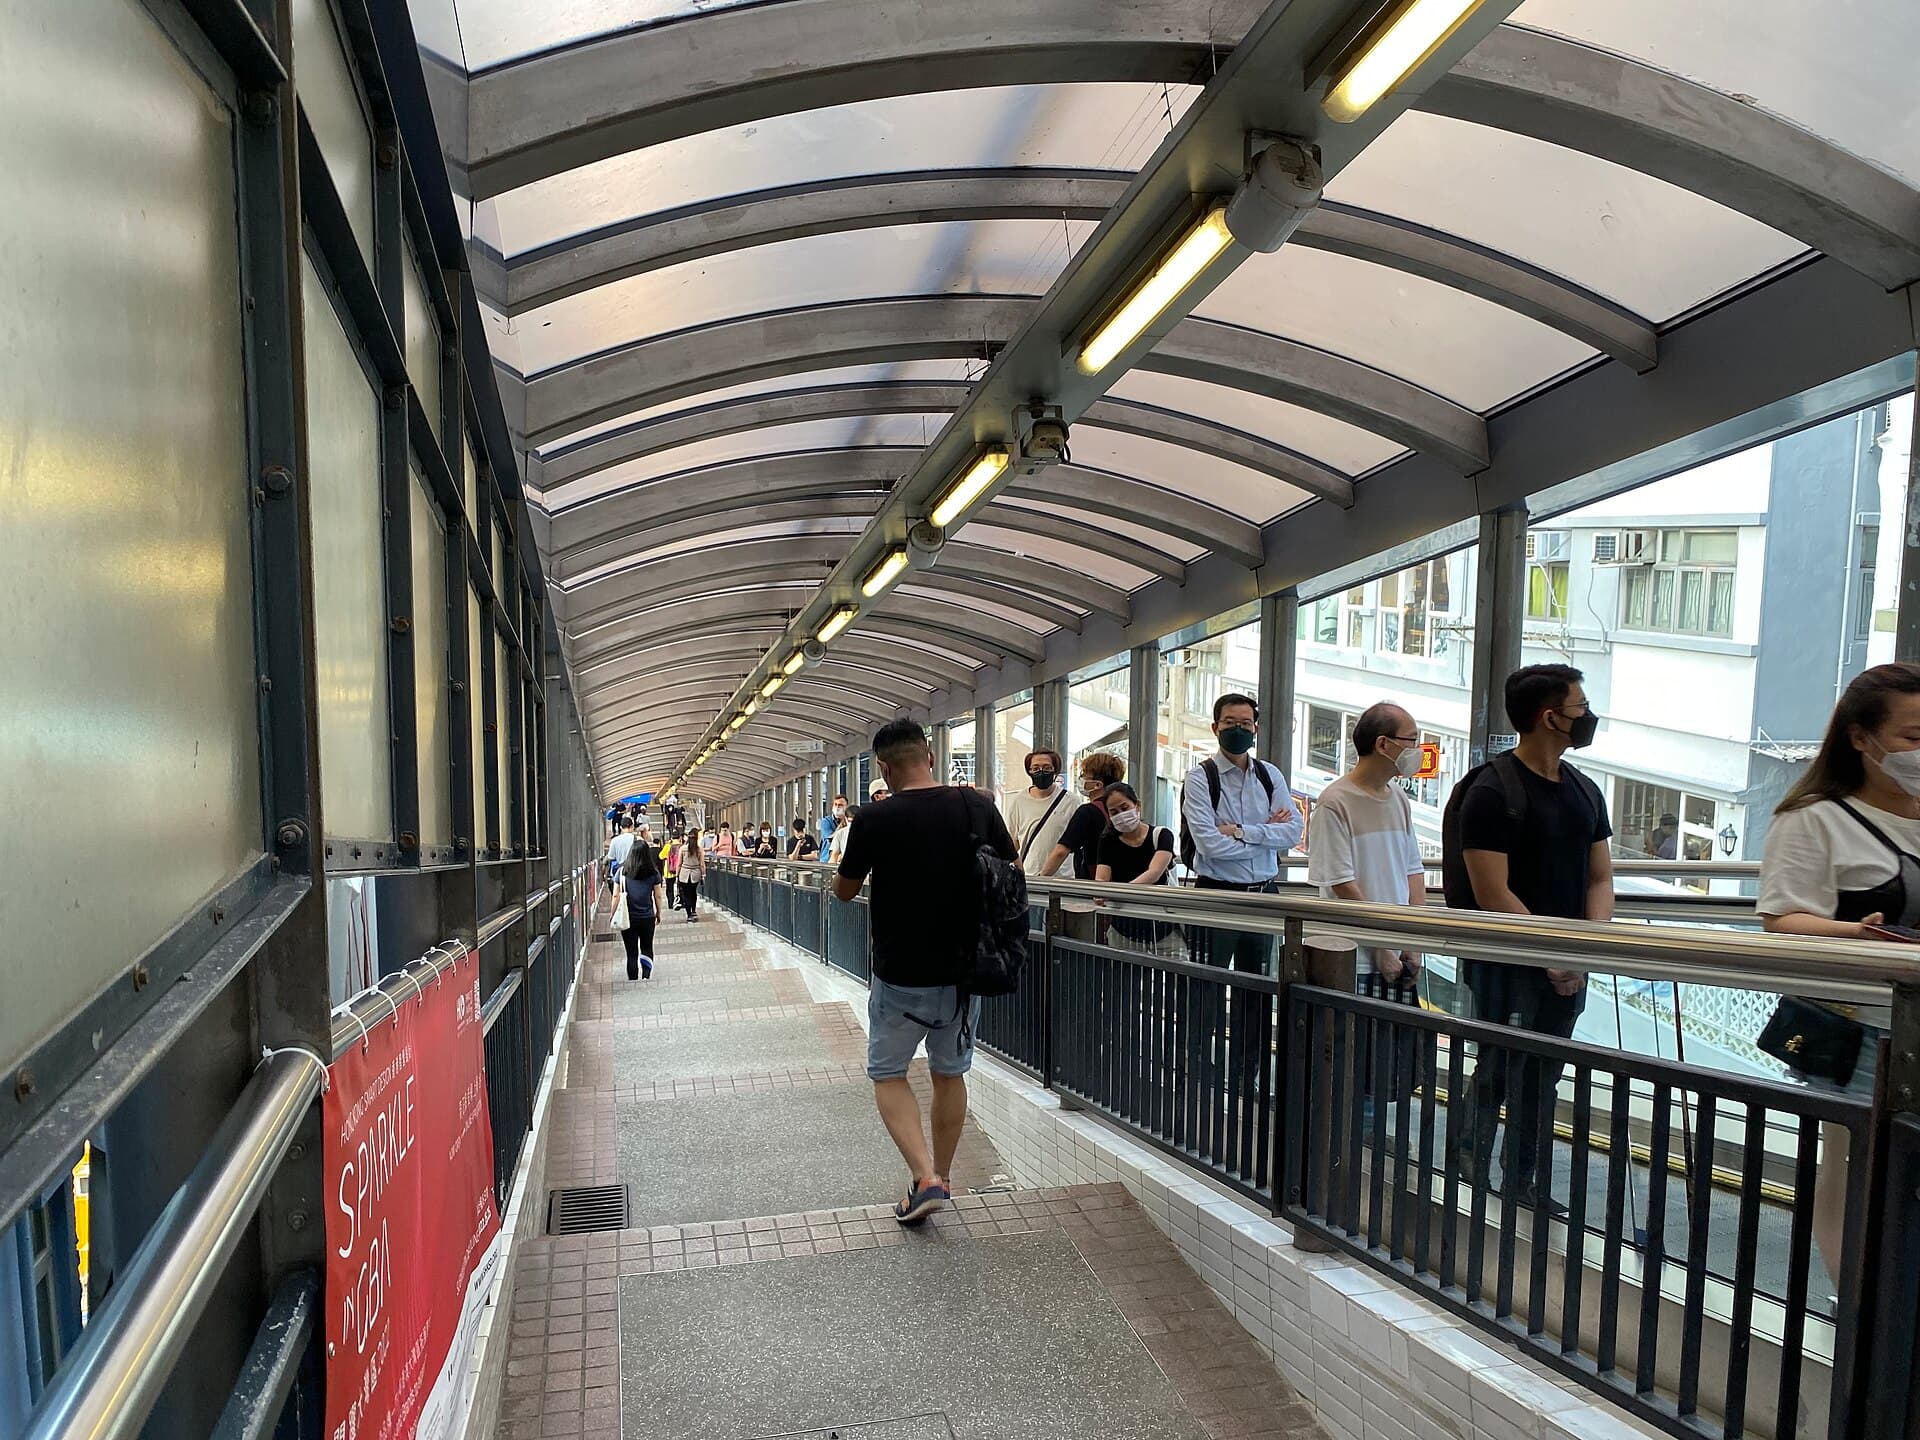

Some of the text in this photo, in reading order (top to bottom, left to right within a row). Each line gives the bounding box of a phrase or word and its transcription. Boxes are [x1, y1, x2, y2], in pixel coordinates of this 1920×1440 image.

[339, 1074, 415, 1258] SPARKLE
[343, 1216, 391, 1354] IN GBA
